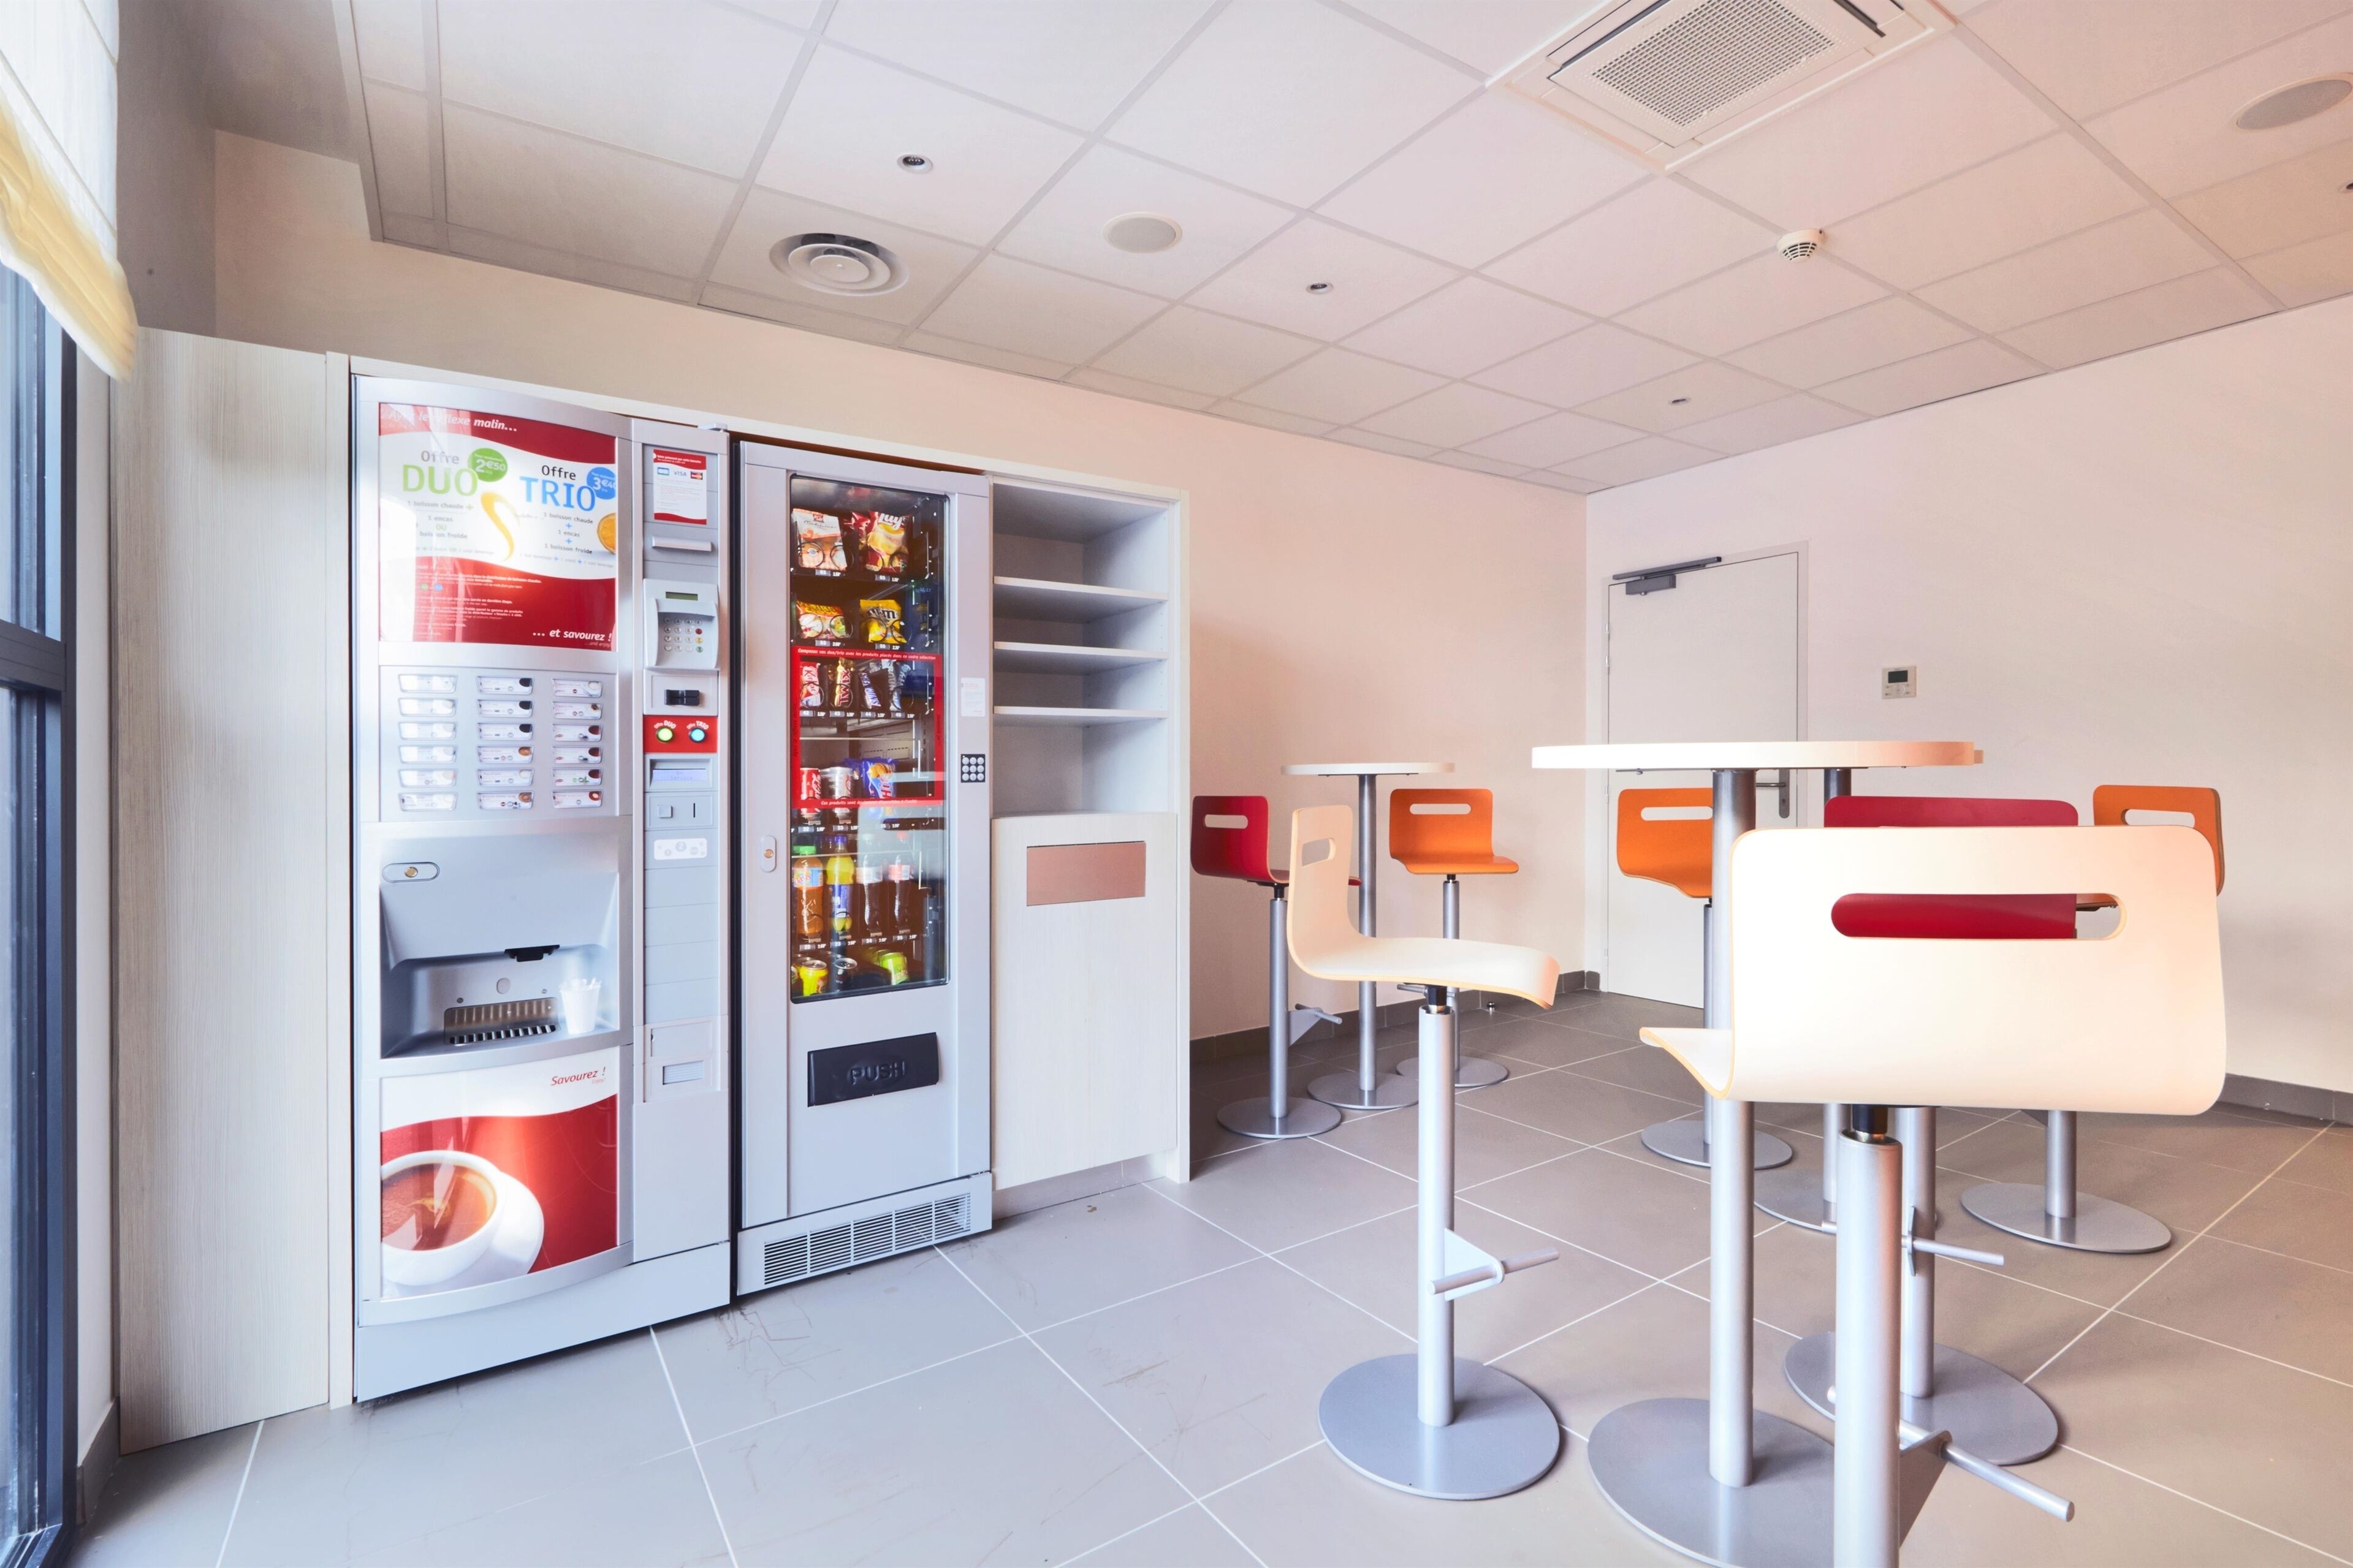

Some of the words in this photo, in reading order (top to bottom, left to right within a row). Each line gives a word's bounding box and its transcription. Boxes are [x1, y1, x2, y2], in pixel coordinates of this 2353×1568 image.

[474, 419, 517, 431] malin...
[421, 450, 460, 464] Offre
[541, 465, 576, 480] Offre
[403, 464, 477, 496] DUO
[520, 475, 596, 512] TRIO
[549, 512, 572, 521] boisson
[549, 629, 561, 638] et
[563, 630, 605, 641] savourez
[664, 720, 677, 729] DUO
[696, 720, 709, 730] TRIO
[551, 1070, 598, 1086] Savourez
[852, 1061, 905, 1085] PUSH
